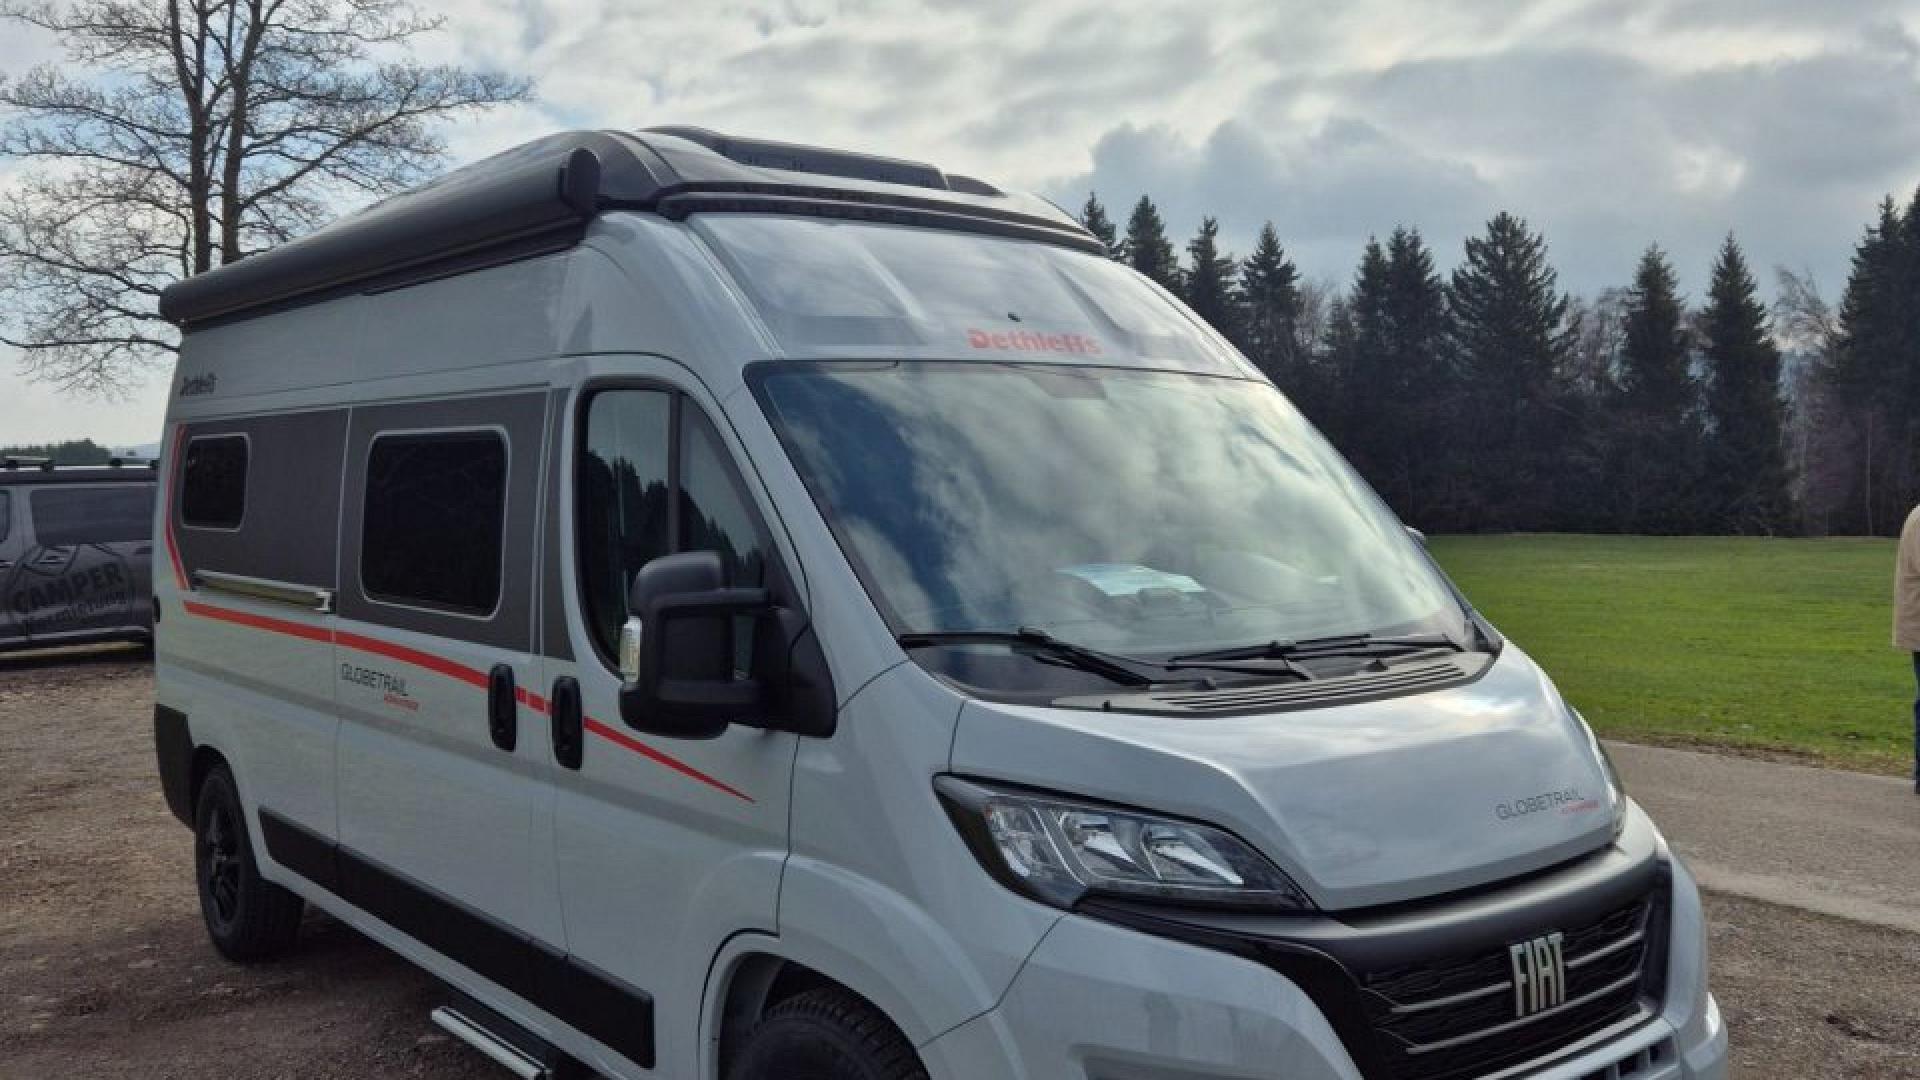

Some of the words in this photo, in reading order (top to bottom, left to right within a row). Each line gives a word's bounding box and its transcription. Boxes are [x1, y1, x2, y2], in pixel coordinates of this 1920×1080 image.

[967, 328, 1103, 354] Dethleffs
[12, 562, 124, 613] CAMPER
[341, 663, 409, 697] GLOBETRAIL
[1496, 787, 1585, 820] GLOBETRAIL
[1509, 932, 1566, 1017] FIAT
